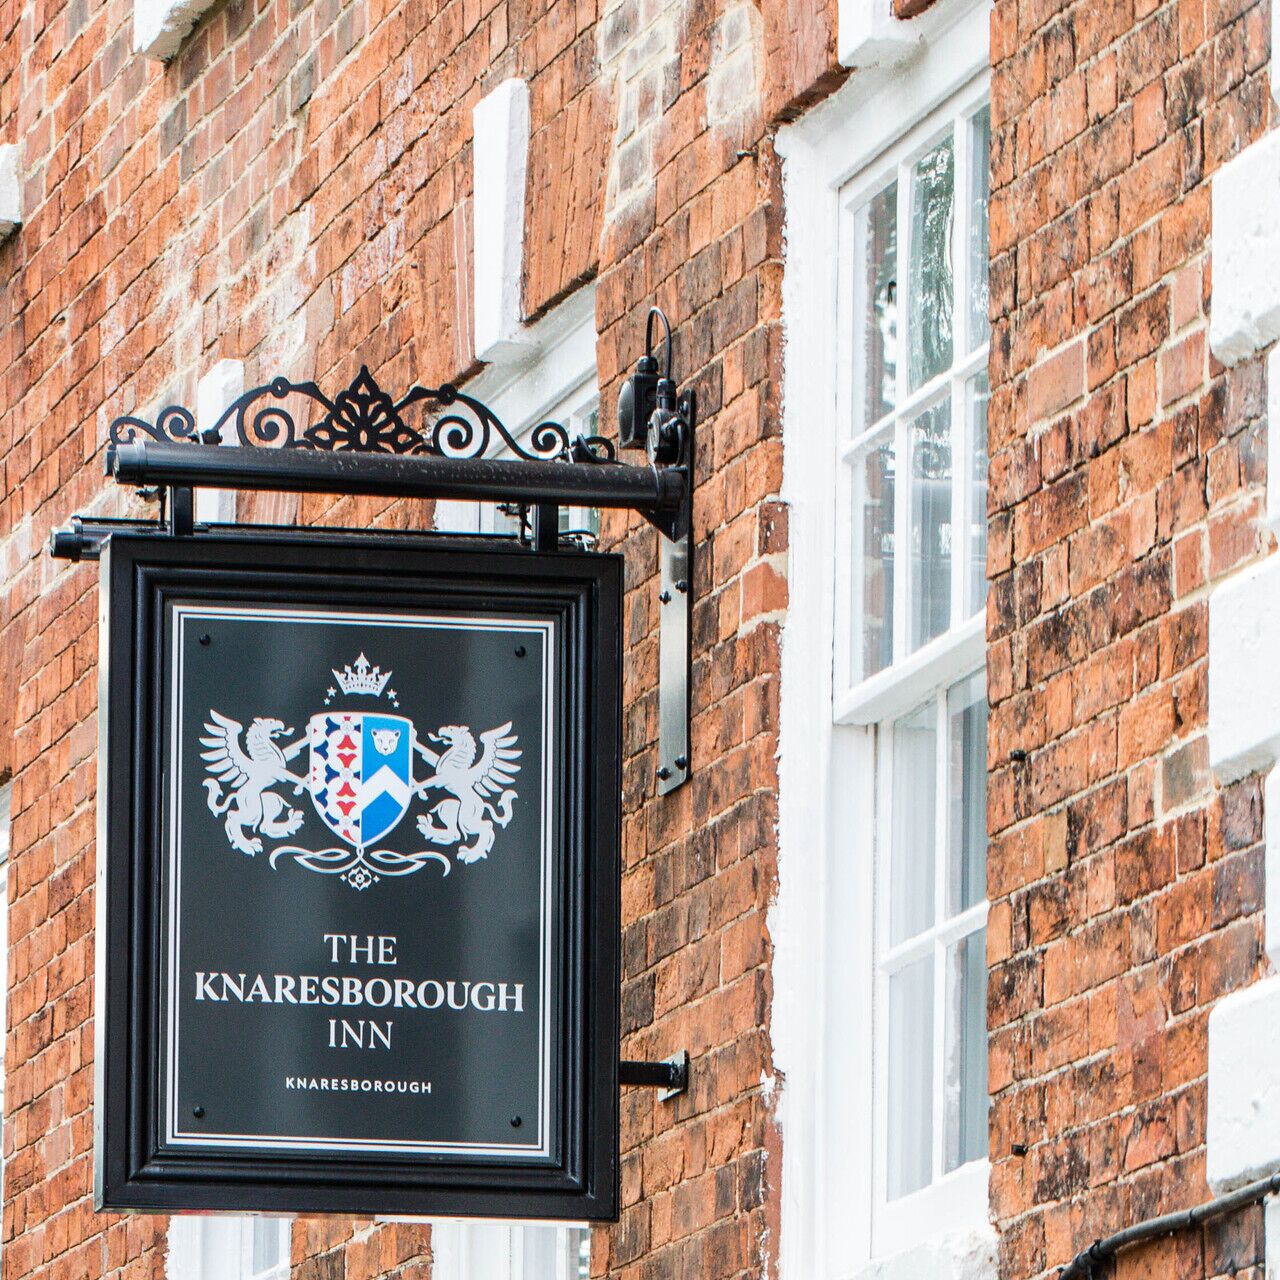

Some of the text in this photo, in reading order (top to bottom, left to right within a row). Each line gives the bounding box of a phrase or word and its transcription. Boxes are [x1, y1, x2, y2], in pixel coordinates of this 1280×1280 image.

[324, 934, 397, 964] THE
[195, 972, 524, 1012] KNARESBOROUGH
[328, 1019, 393, 1049] INN
[286, 1077, 431, 1093] KNARESBOROUGH
